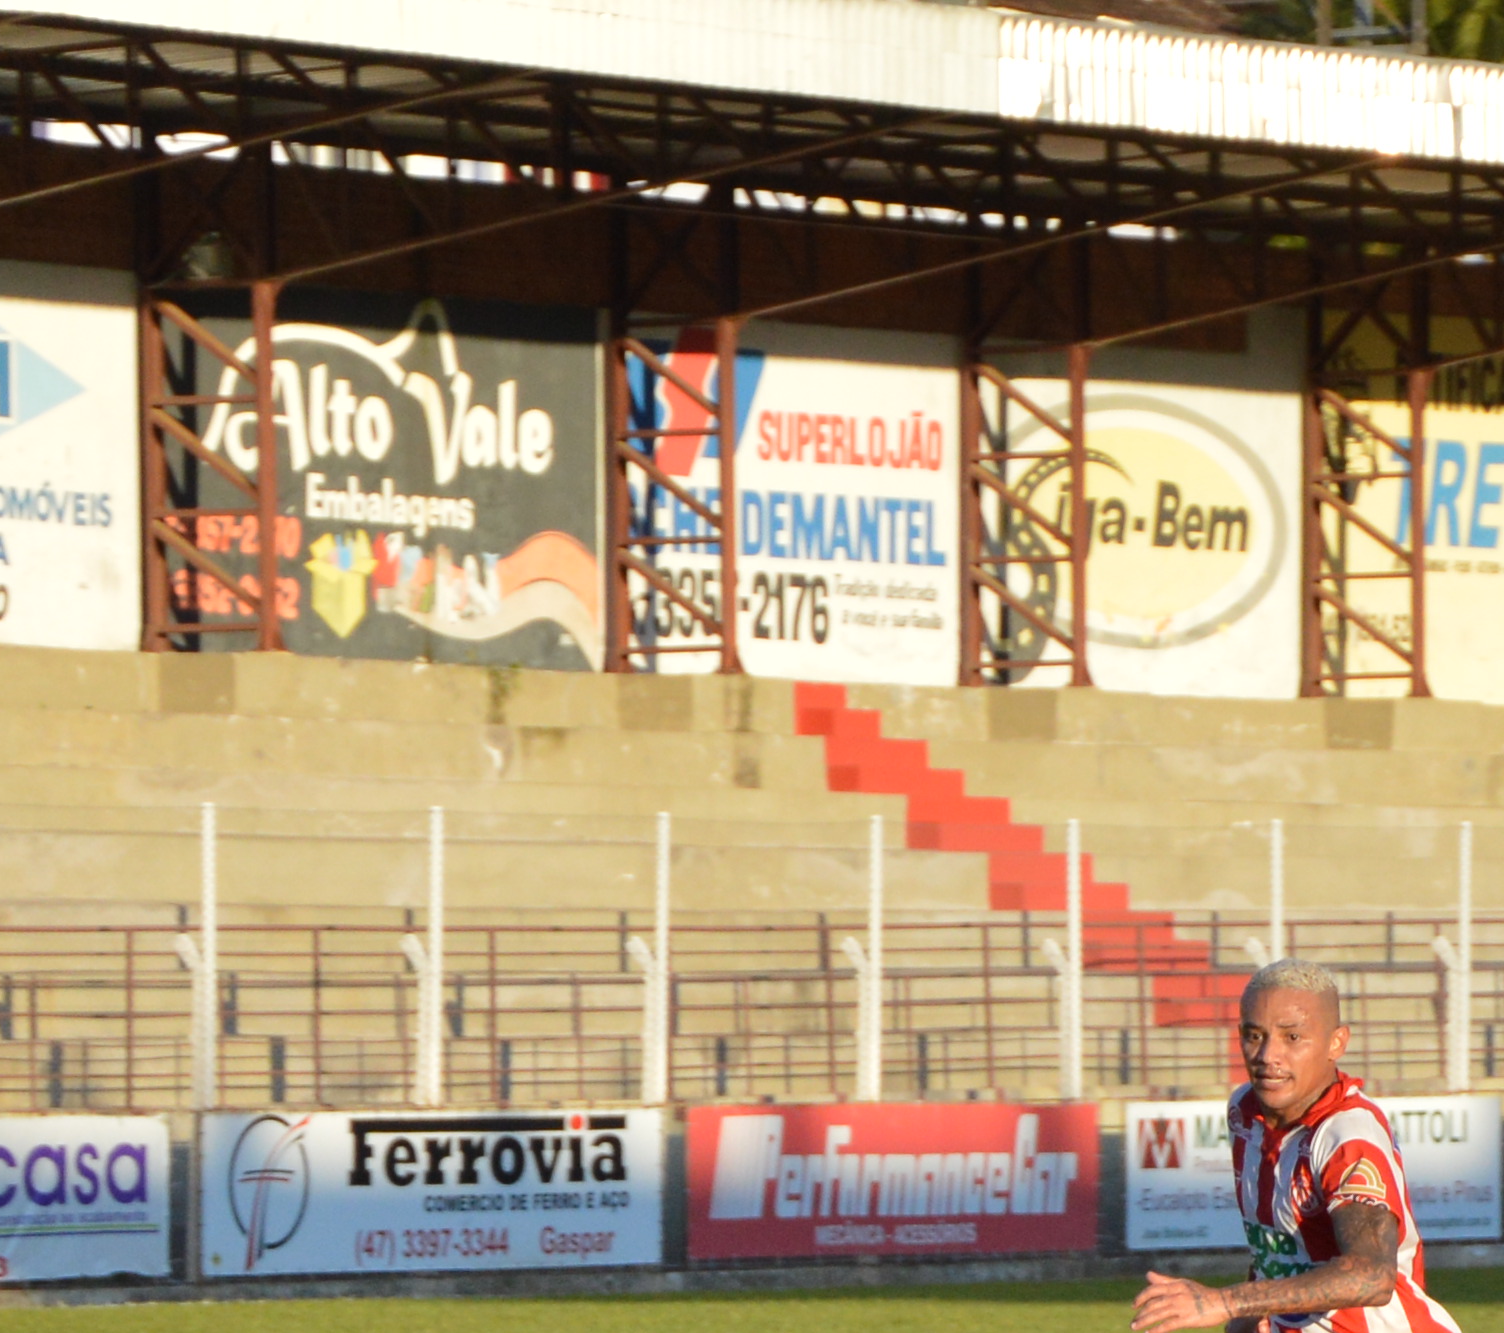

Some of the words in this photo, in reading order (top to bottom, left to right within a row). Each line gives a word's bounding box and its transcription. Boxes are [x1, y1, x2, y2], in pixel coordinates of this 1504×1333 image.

[224, 357, 393, 473] Alto
[403, 371, 554, 487] Vale
[757, 410, 944, 472] SUPERLOJÃO
[305, 473, 476, 538] Embalagens
[739, 490, 946, 566] DEMANTEL
[1058, 480, 1249, 557] ia-Bem
[654, 565, 830, 645] 335-2176
[349, 1114, 627, 1187] Ferrovia
[533, 1192, 582, 1211] FERRO
[539, 1225, 616, 1261] Gaspar
